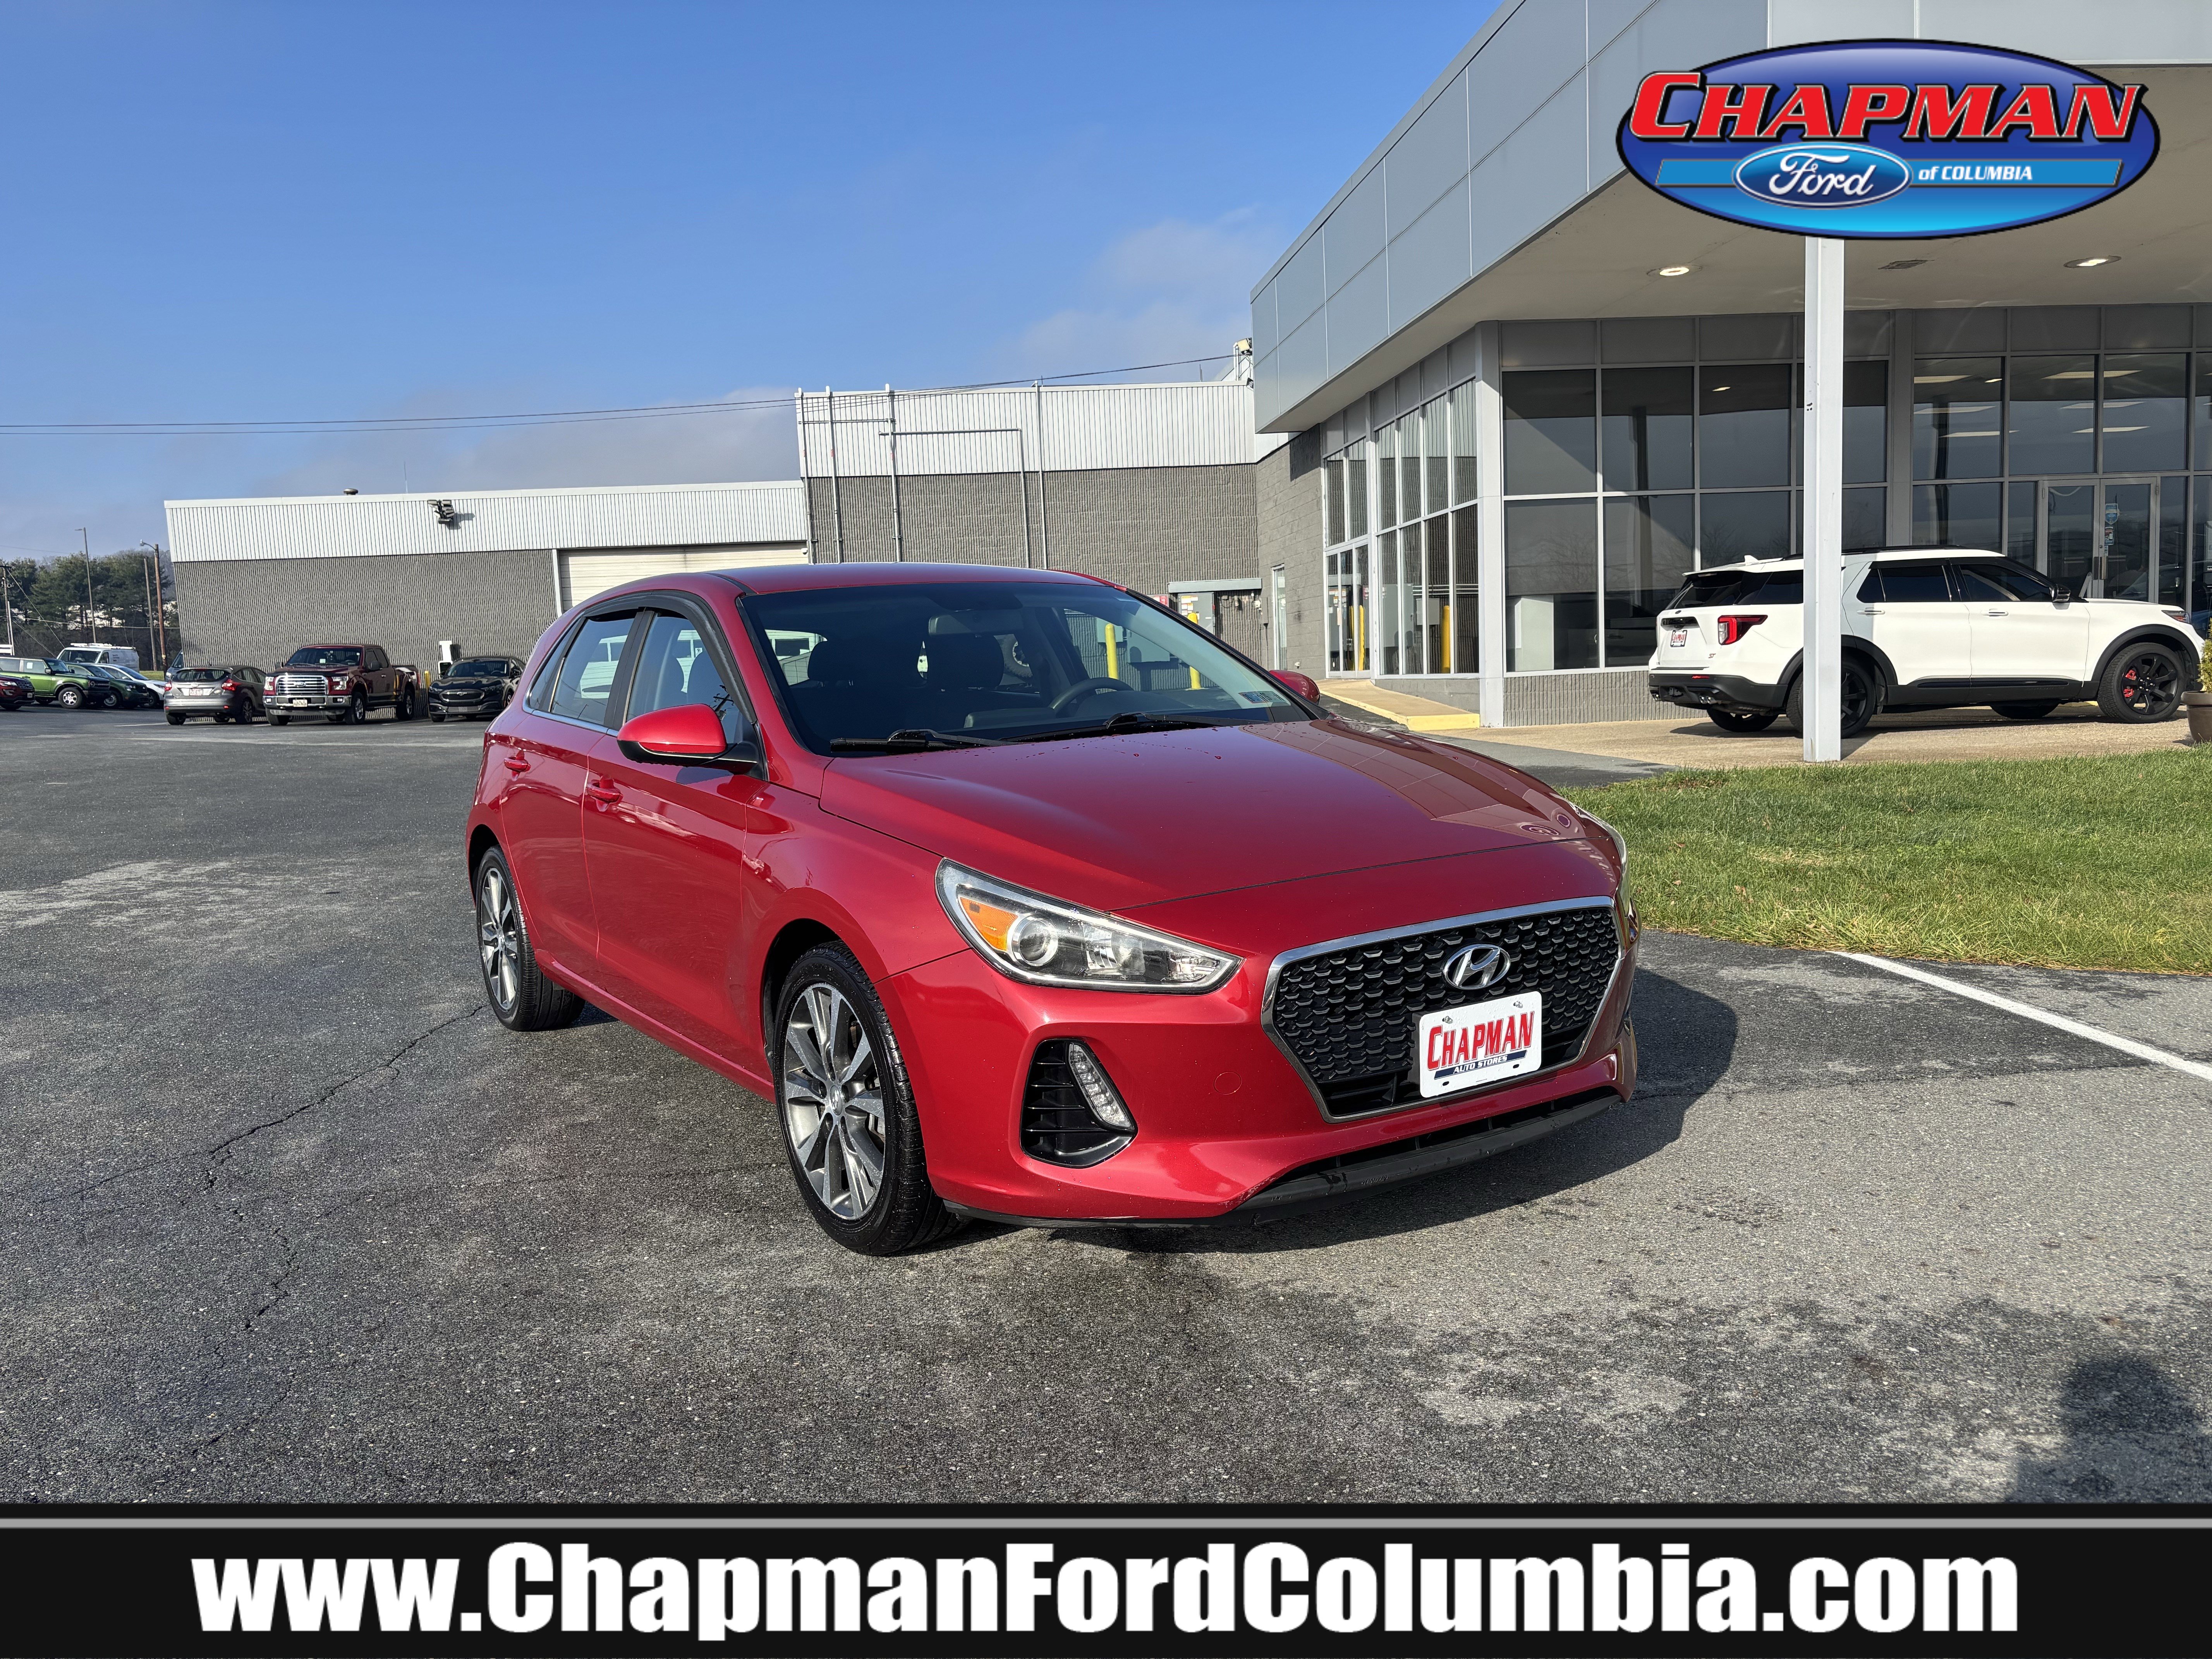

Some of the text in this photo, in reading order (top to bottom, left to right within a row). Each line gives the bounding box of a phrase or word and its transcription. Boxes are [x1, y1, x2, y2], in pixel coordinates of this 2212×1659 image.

[1427, 1011, 1534, 1071] CHAPMAN
[1453, 1055, 1508, 1073] AUTO STORES
